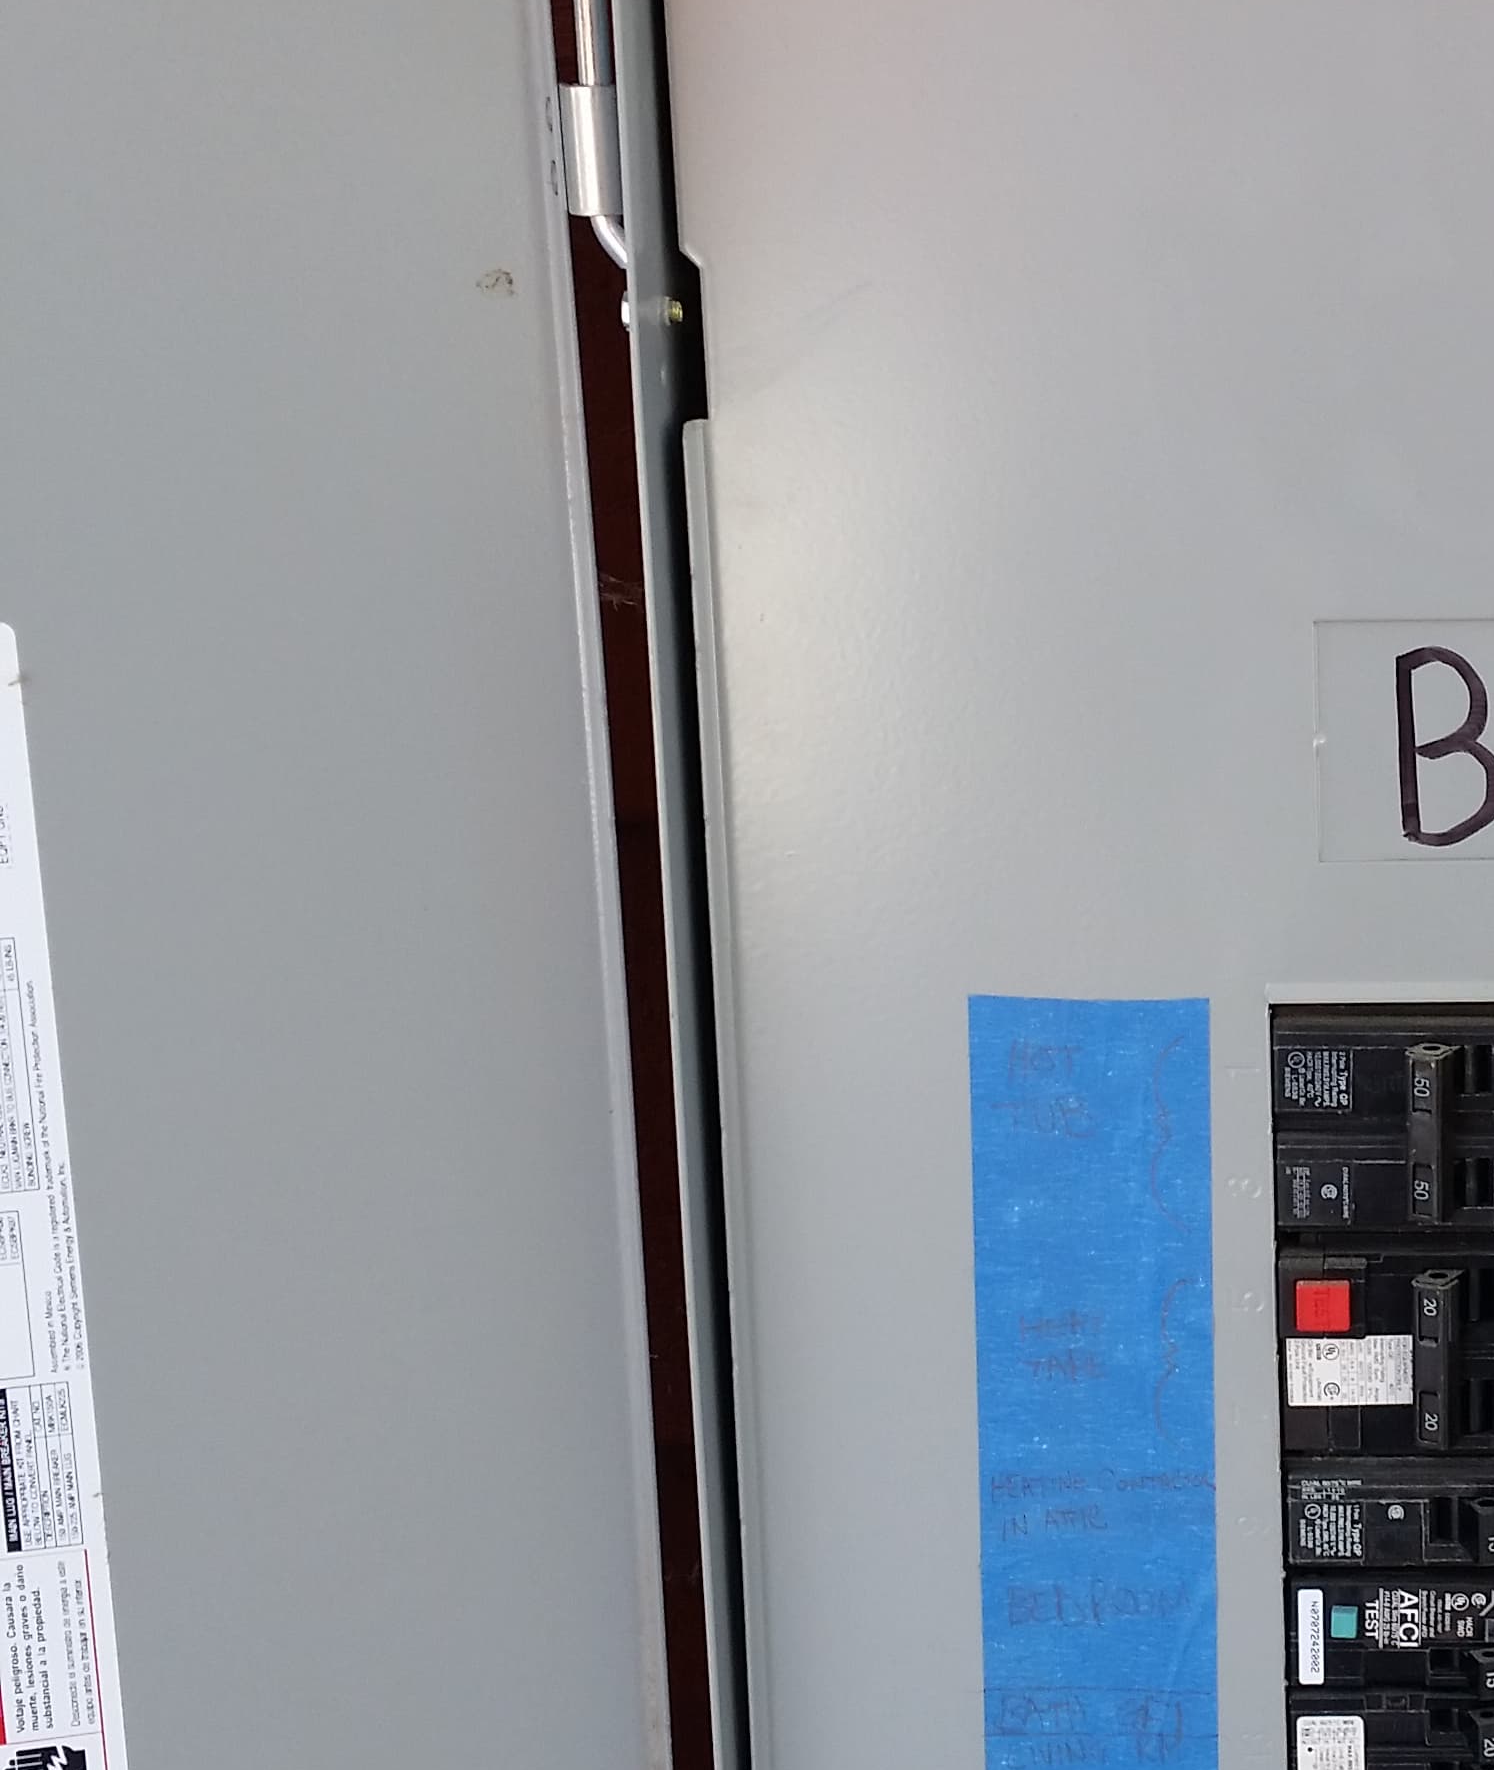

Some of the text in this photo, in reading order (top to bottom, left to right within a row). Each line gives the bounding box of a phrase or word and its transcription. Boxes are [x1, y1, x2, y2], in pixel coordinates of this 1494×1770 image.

[1337, 1070, 1349, 1091] Type
[1414, 1180, 1429, 1200] 50
[1423, 1298, 1437, 1317] 20
[1425, 1413, 1438, 1431] 20
[1, 1466, 13, 1490] MAIN
[4, 1497, 16, 1517] LUG
[6, 1518, 19, 1542] MAIN
[1351, 1523, 1362, 1543] Type
[0, 1581, 12, 1592] la
[19, 1605, 33, 1640] graves
[30, 1586, 46, 1642] propiedad.
[1365, 1599, 1379, 1640] TEST
[1399, 1589, 1419, 1648] AFCI
[36, 1646, 46, 1656] la
[7, 1642, 24, 1694] peligroso.
[22, 1644, 35, 1688] lesiones
[27, 1691, 40, 1731] muerte,
[38, 1669, 54, 1729] substancial
[12, 1697, 28, 1733] Voltaje
